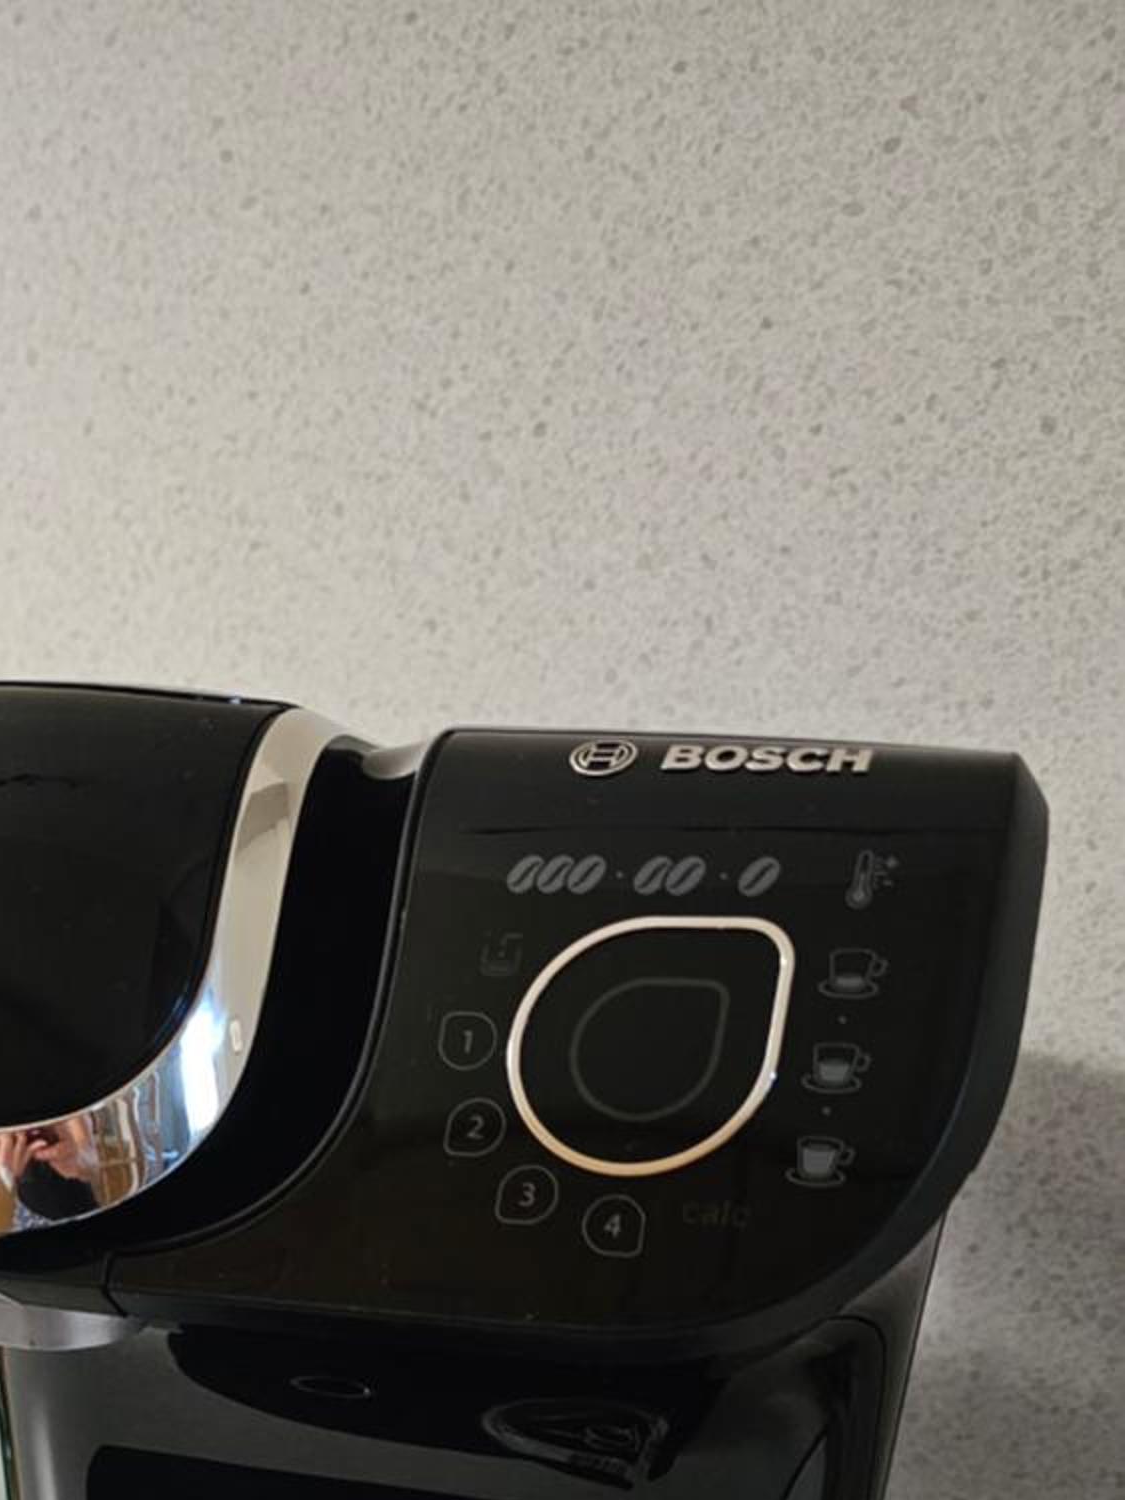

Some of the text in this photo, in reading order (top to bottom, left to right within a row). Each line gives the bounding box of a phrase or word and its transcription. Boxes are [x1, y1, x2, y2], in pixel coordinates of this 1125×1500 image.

[660, 744, 874, 774] BOSCH
[463, 1030, 473, 1053] 1
[467, 1115, 484, 1139] 2
[519, 1182, 536, 1207] 3
[604, 1214, 621, 1237] 4
